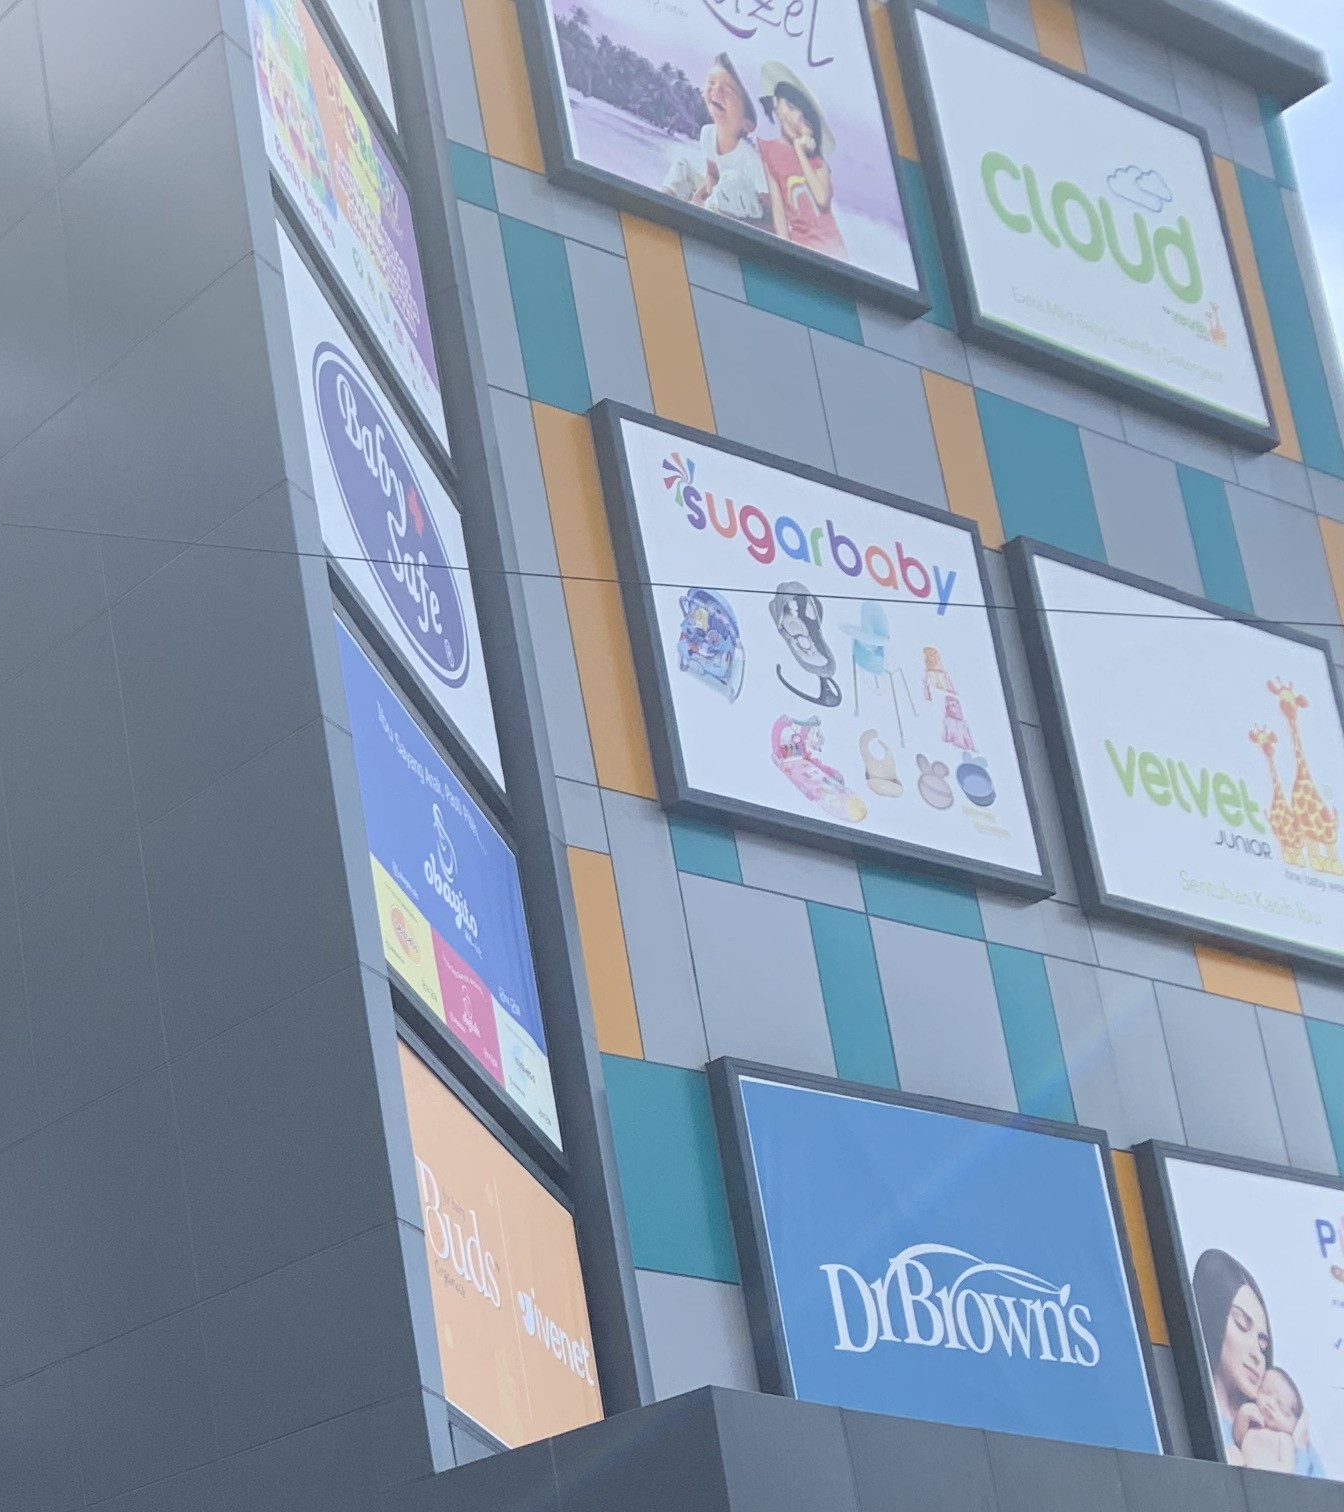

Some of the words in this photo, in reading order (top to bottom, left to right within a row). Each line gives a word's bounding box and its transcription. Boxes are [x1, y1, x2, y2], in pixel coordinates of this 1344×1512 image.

[335, 373, 408, 535] Baby
[386, 512, 443, 636] Safe
[682, 480, 957, 616] sugarbaby
[1104, 738, 1266, 835] velvet
[414, 1155, 501, 1308] Buds
